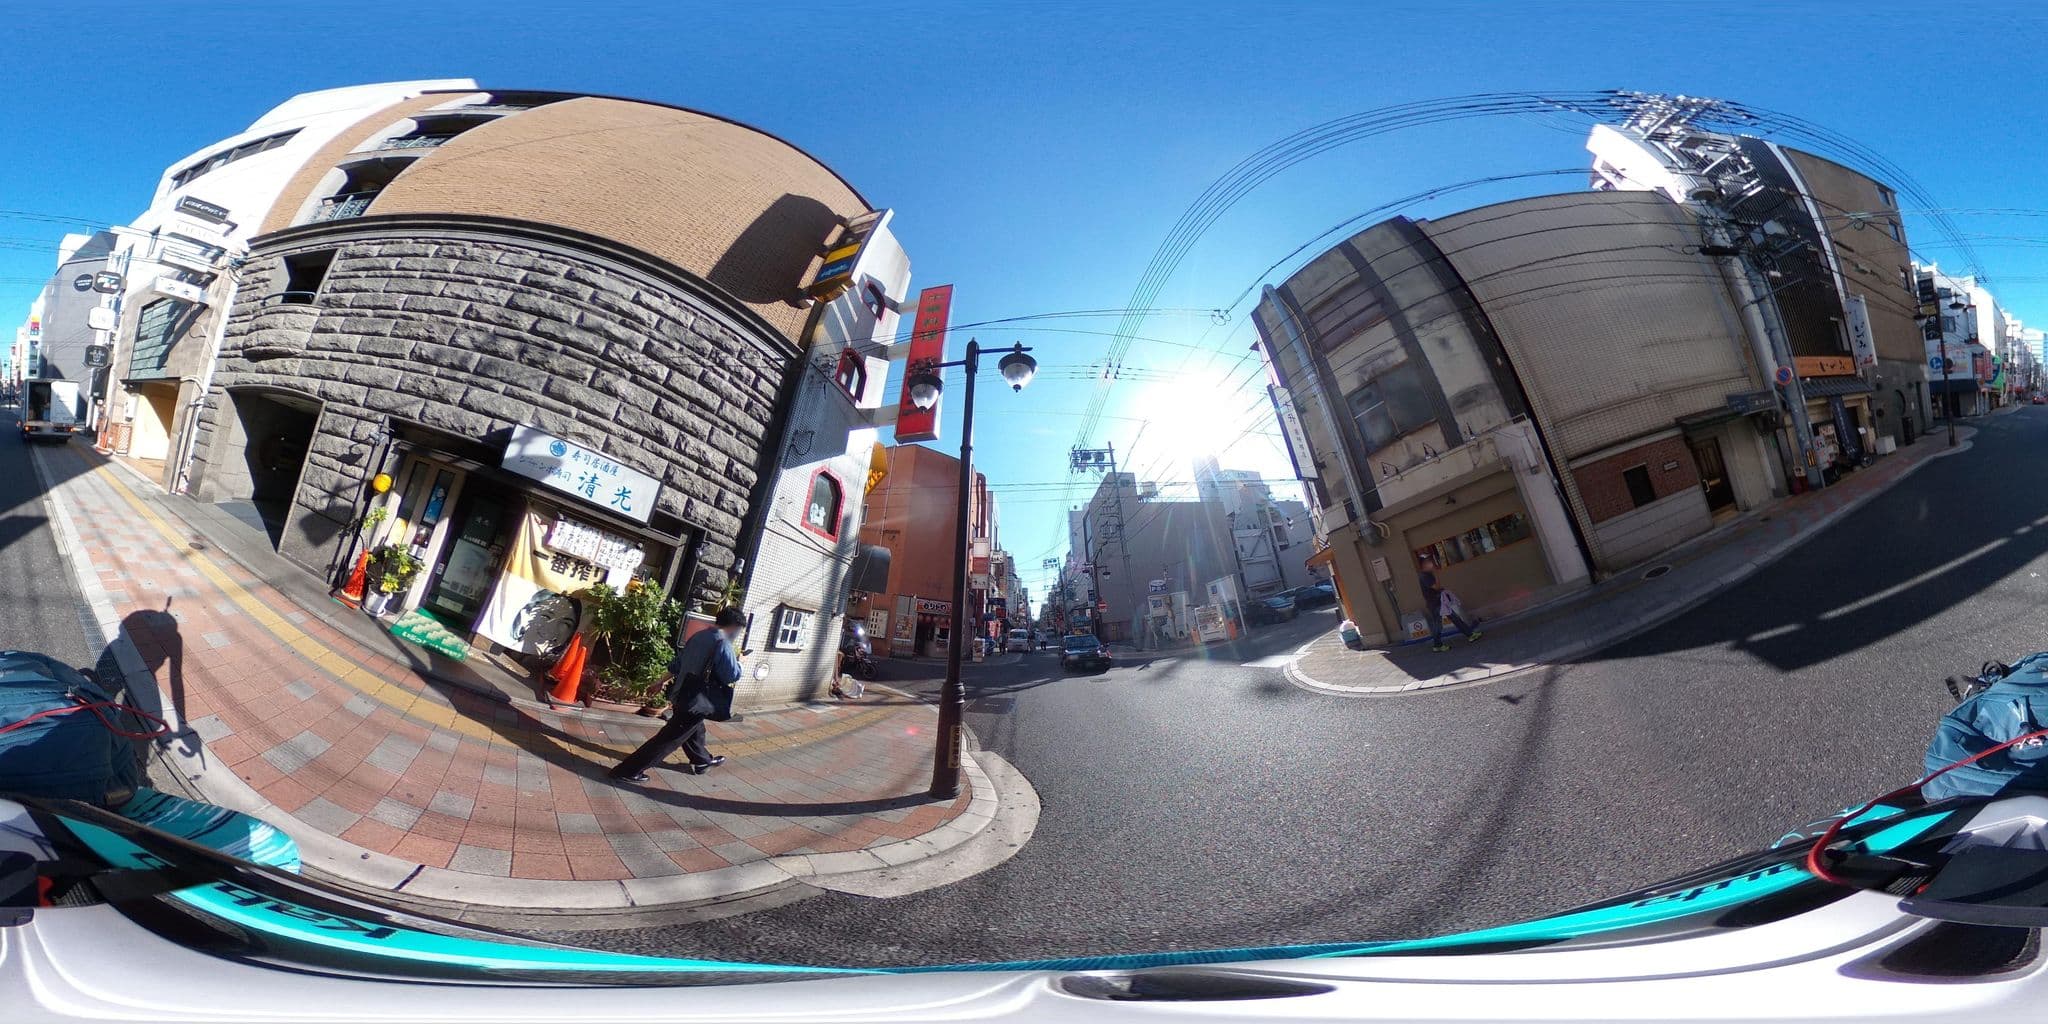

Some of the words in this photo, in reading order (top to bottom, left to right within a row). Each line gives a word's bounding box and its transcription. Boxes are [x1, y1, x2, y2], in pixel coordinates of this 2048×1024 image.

[571, 450, 622, 477] 寿司居酒屋
